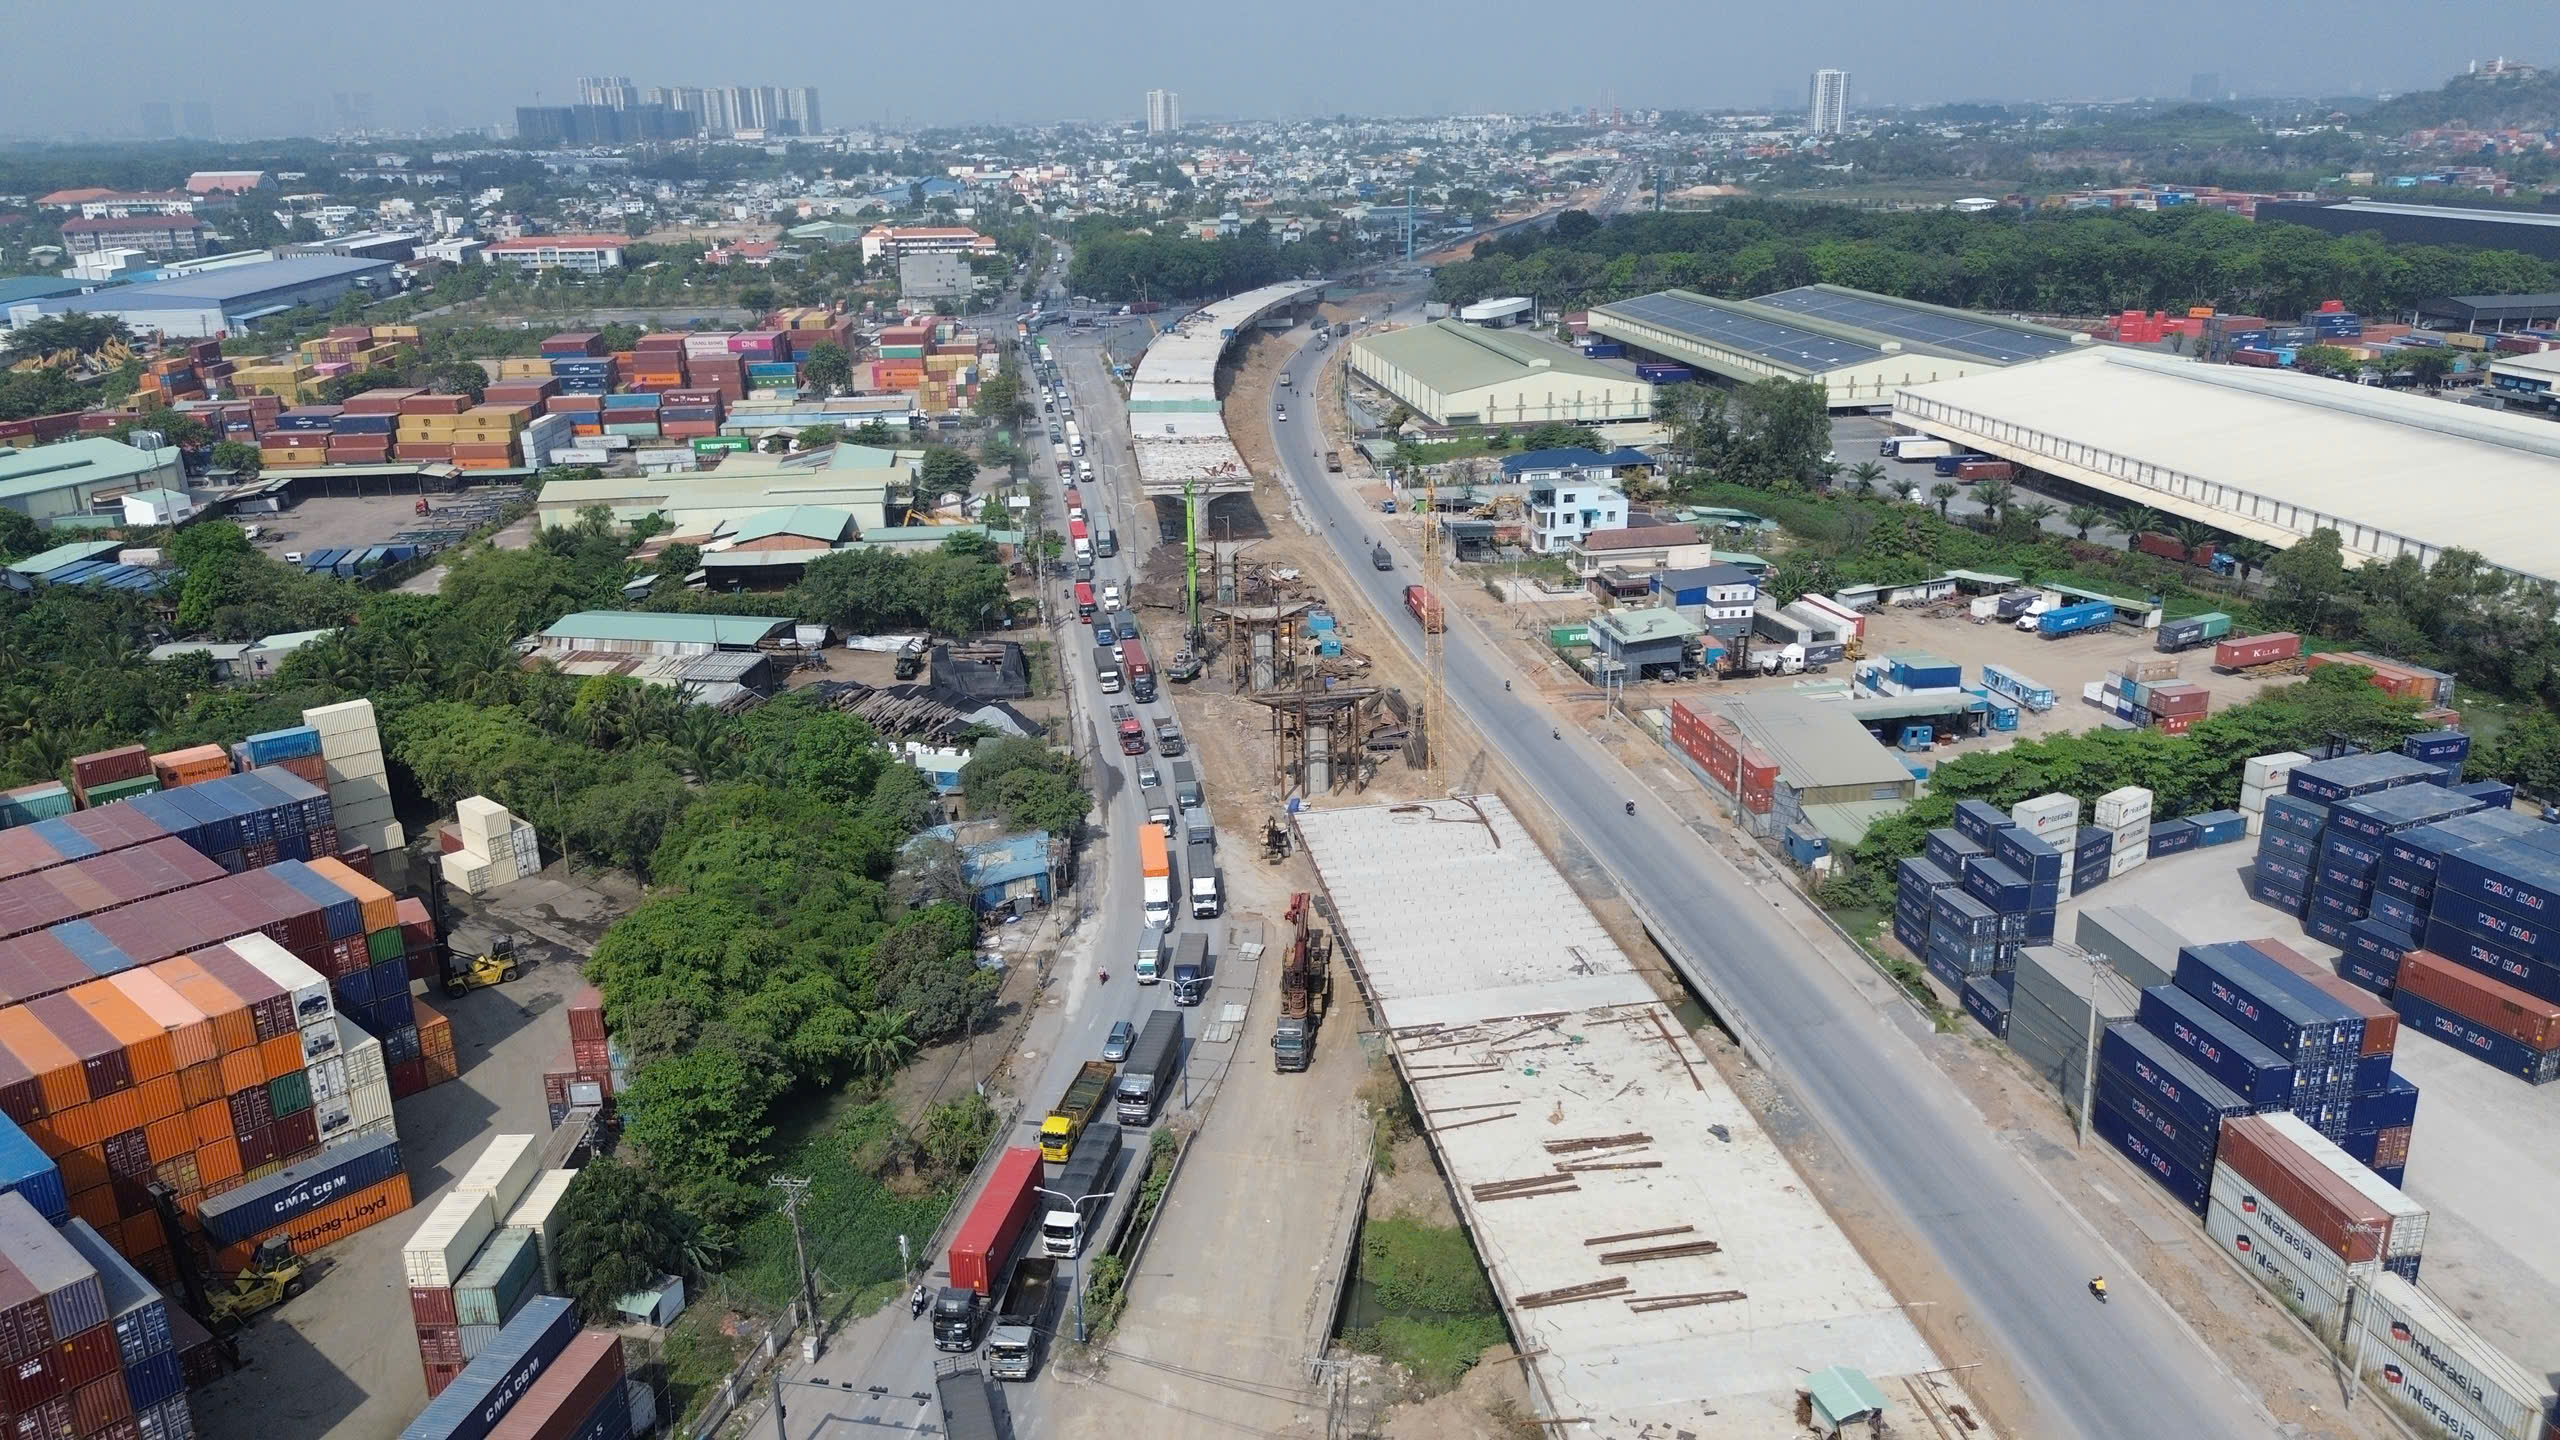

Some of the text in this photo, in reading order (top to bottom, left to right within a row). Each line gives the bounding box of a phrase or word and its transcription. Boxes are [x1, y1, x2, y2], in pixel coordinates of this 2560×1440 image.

[2484, 878, 2544, 910] WAN HAI
[2478, 912, 2537, 944] WAN HAI
[2471, 945, 2529, 978] WAN HAI
[2211, 980, 2260, 1022] WAN HAI
[2174, 1021, 2221, 1064] WAN HAI
[2435, 1016, 2493, 1050] WAN HAI
[274, 1174, 348, 1213] CMA CGM
[289, 1195, 388, 1246] Hapag-Lloyd
[2257, 1202, 2313, 1261] Interasia
[2251, 1244, 2305, 1302] Interasia
[2409, 1332, 2484, 1403] Interasia
[485, 1356, 541, 1423] CMA CGM
[2403, 1376, 2476, 1440] Interasia
